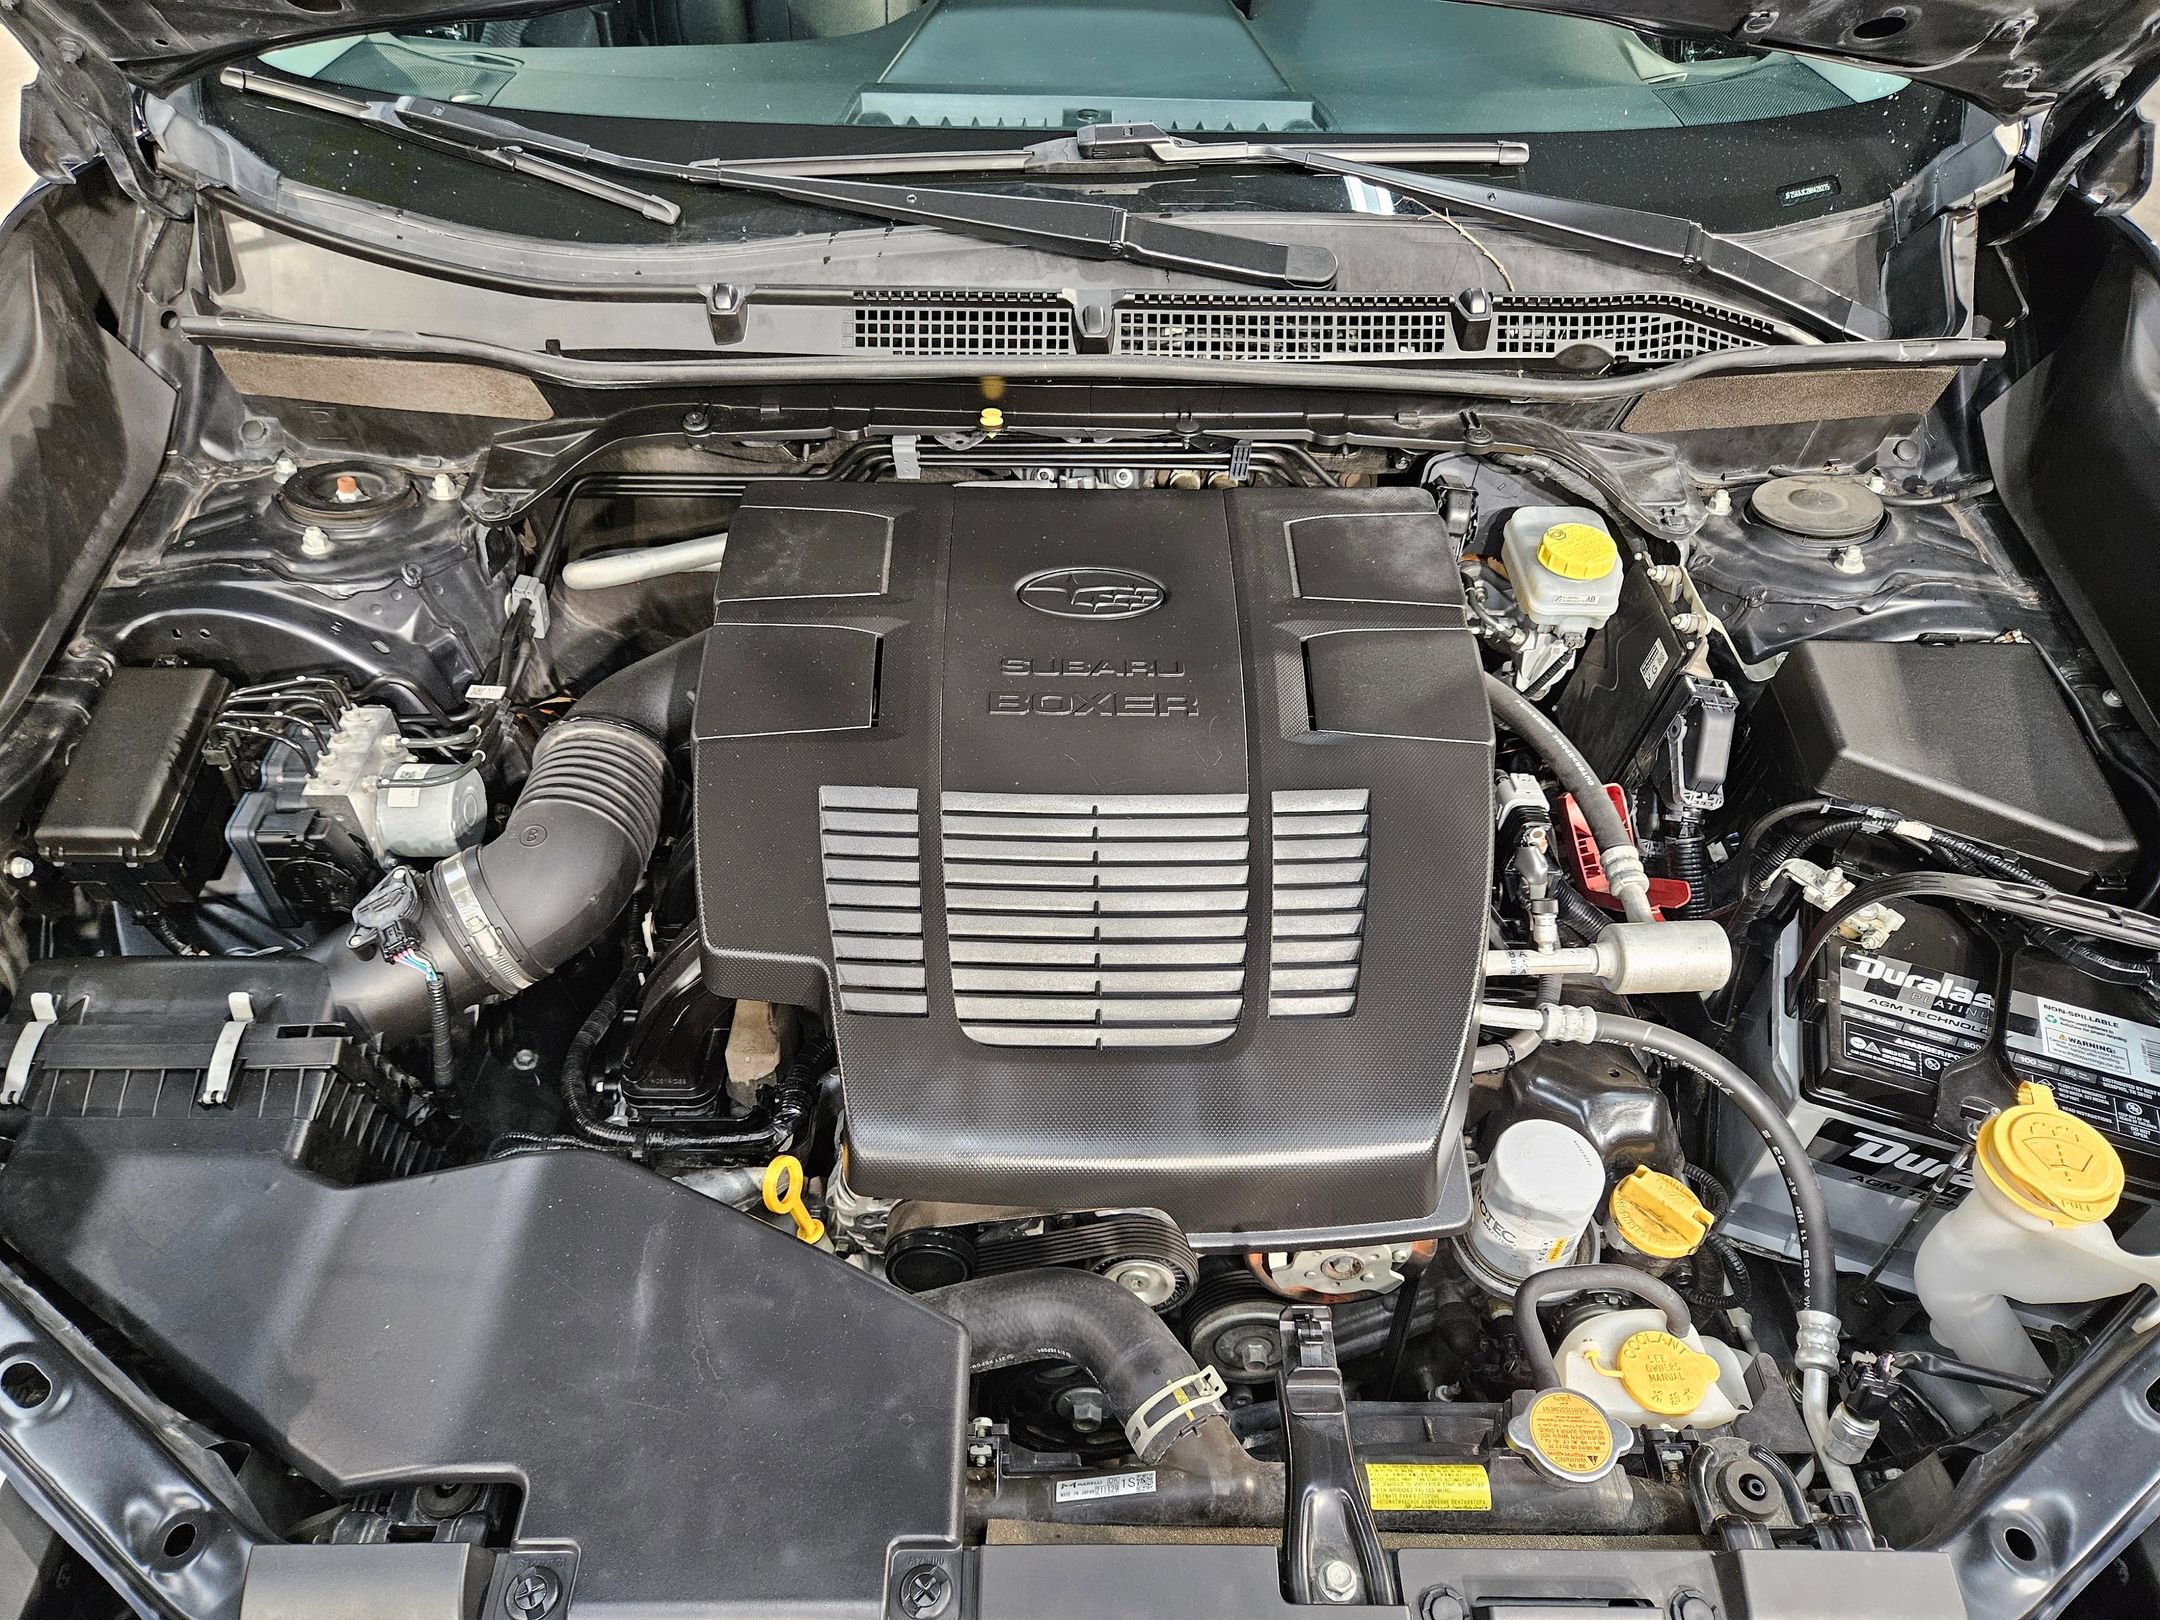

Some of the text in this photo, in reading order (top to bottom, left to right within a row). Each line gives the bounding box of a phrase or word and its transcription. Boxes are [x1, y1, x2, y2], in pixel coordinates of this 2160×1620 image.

[1000, 658, 1184, 678] SUBARU
[988, 691, 1199, 716] BOXER
[526, 828, 538, 842] B
[1850, 953, 1994, 1012] Duralas
[1868, 998, 1991, 1036] AGM TECHNOLO
[1910, 993, 1990, 1020] PLATINU
[2044, 1004, 2120, 1028] NON-SPILLABLE
[2068, 1037, 2116, 1054] WARNING:
[2020, 1056, 2036, 1066] 100
[1682, 1060, 1722, 1088] YOKOHAMA
[2064, 1068, 2076, 1077] 55
[1849, 1131, 1976, 1189] Dura
[1850, 1175, 1902, 1192] AGM
[1480, 1199, 1517, 1244] OTEC
[1796, 1206, 1805, 1224] HP
[1624, 1333, 1688, 1359] COOLANT
[1648, 1355, 1666, 1363] SEE
[1648, 1372, 1685, 1382] MANUAL
